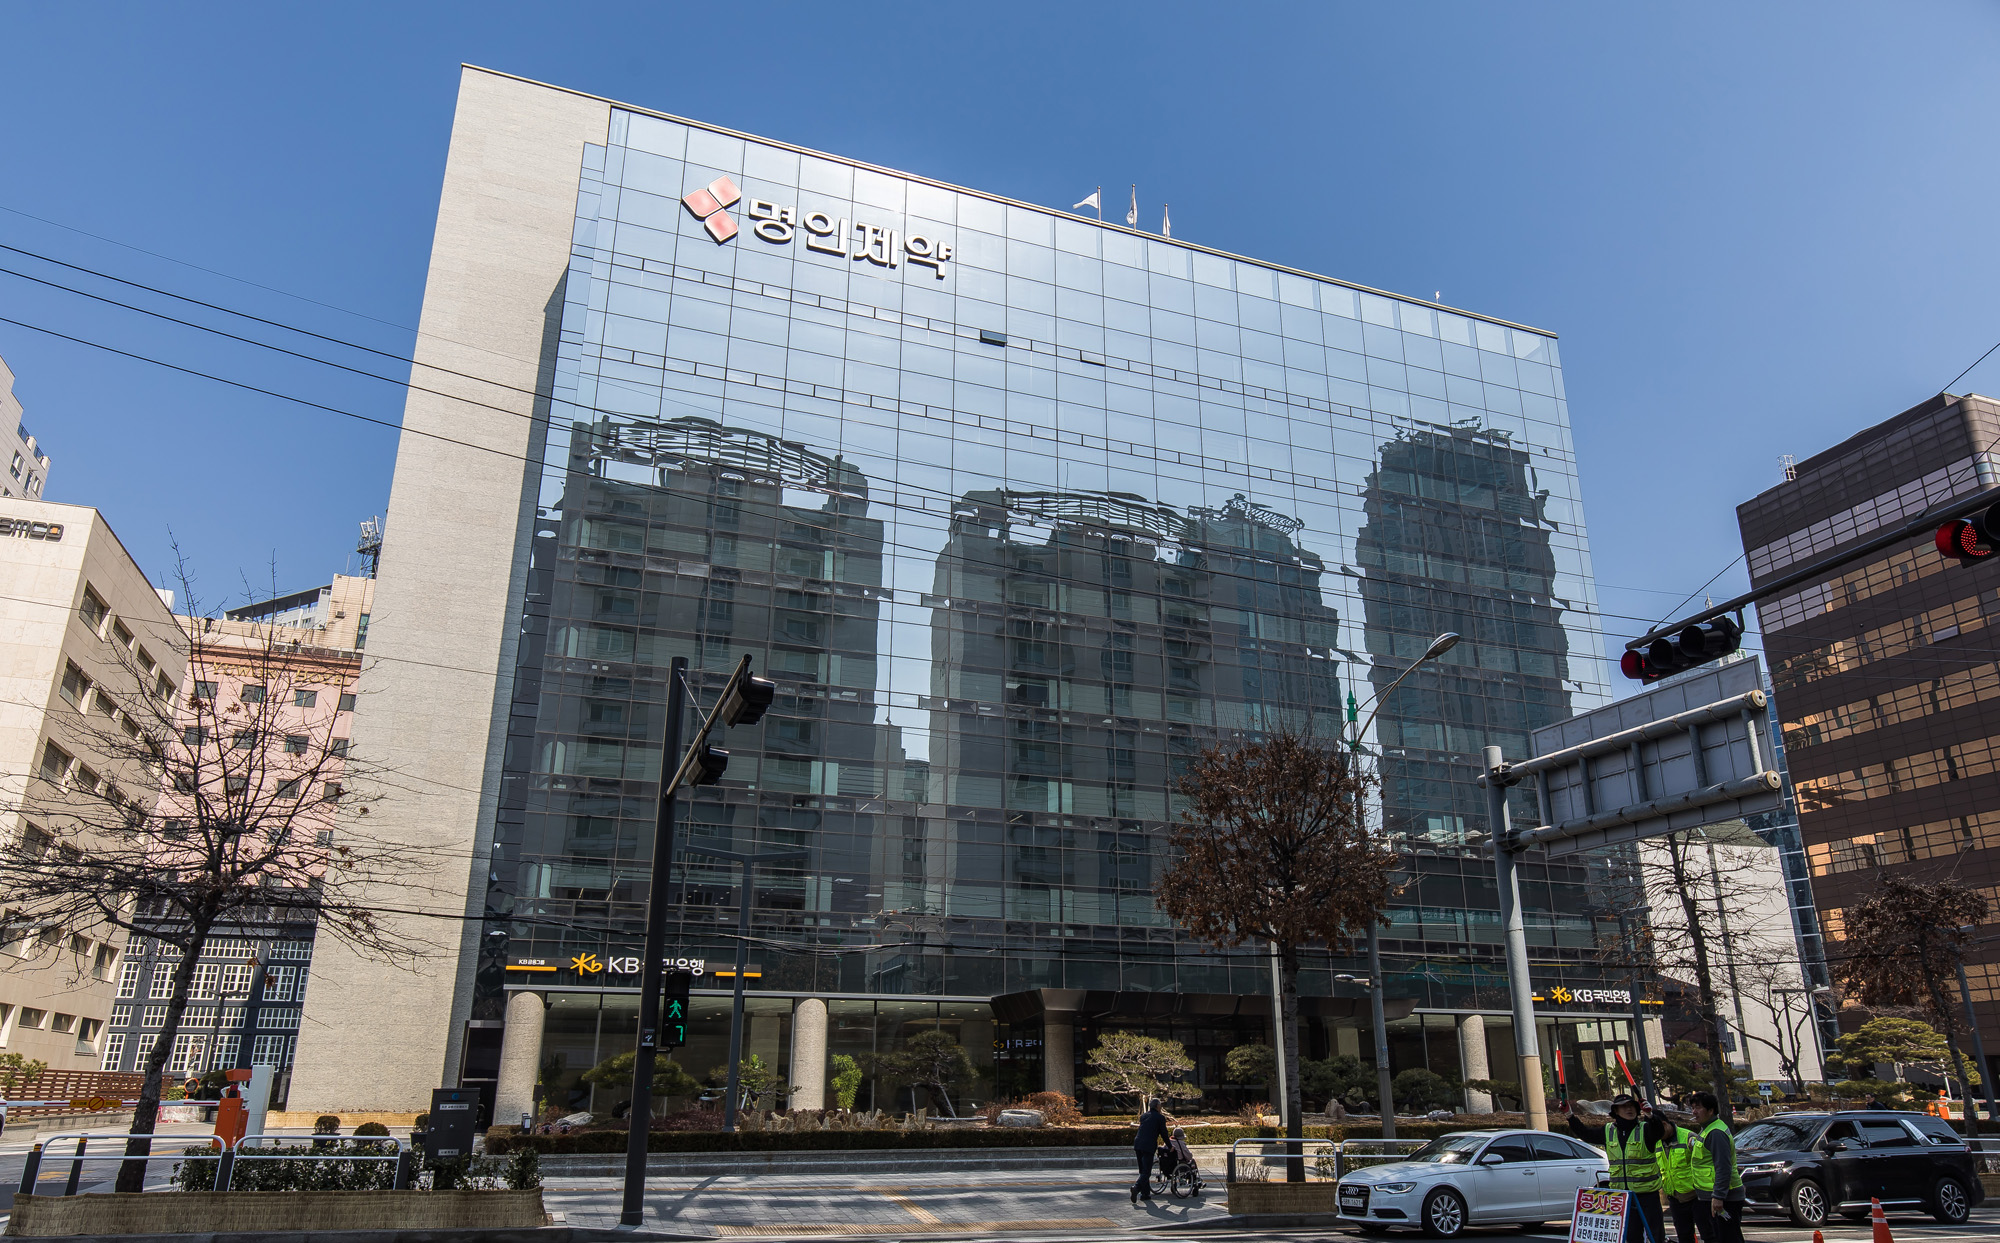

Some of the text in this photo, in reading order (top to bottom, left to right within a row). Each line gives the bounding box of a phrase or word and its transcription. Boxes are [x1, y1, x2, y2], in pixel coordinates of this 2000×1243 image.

[748, 198, 952, 280] 명인제약
[608, 956, 705, 976] KB민은행
[1573, 989, 1631, 1004] KB국민은행
[1580, 1193, 1623, 1213] 공사중
[1578, 1216, 1620, 1230] 통행에 불편을 드려
[1577, 1228, 1618, 1242] 대단히 죄송합니다
